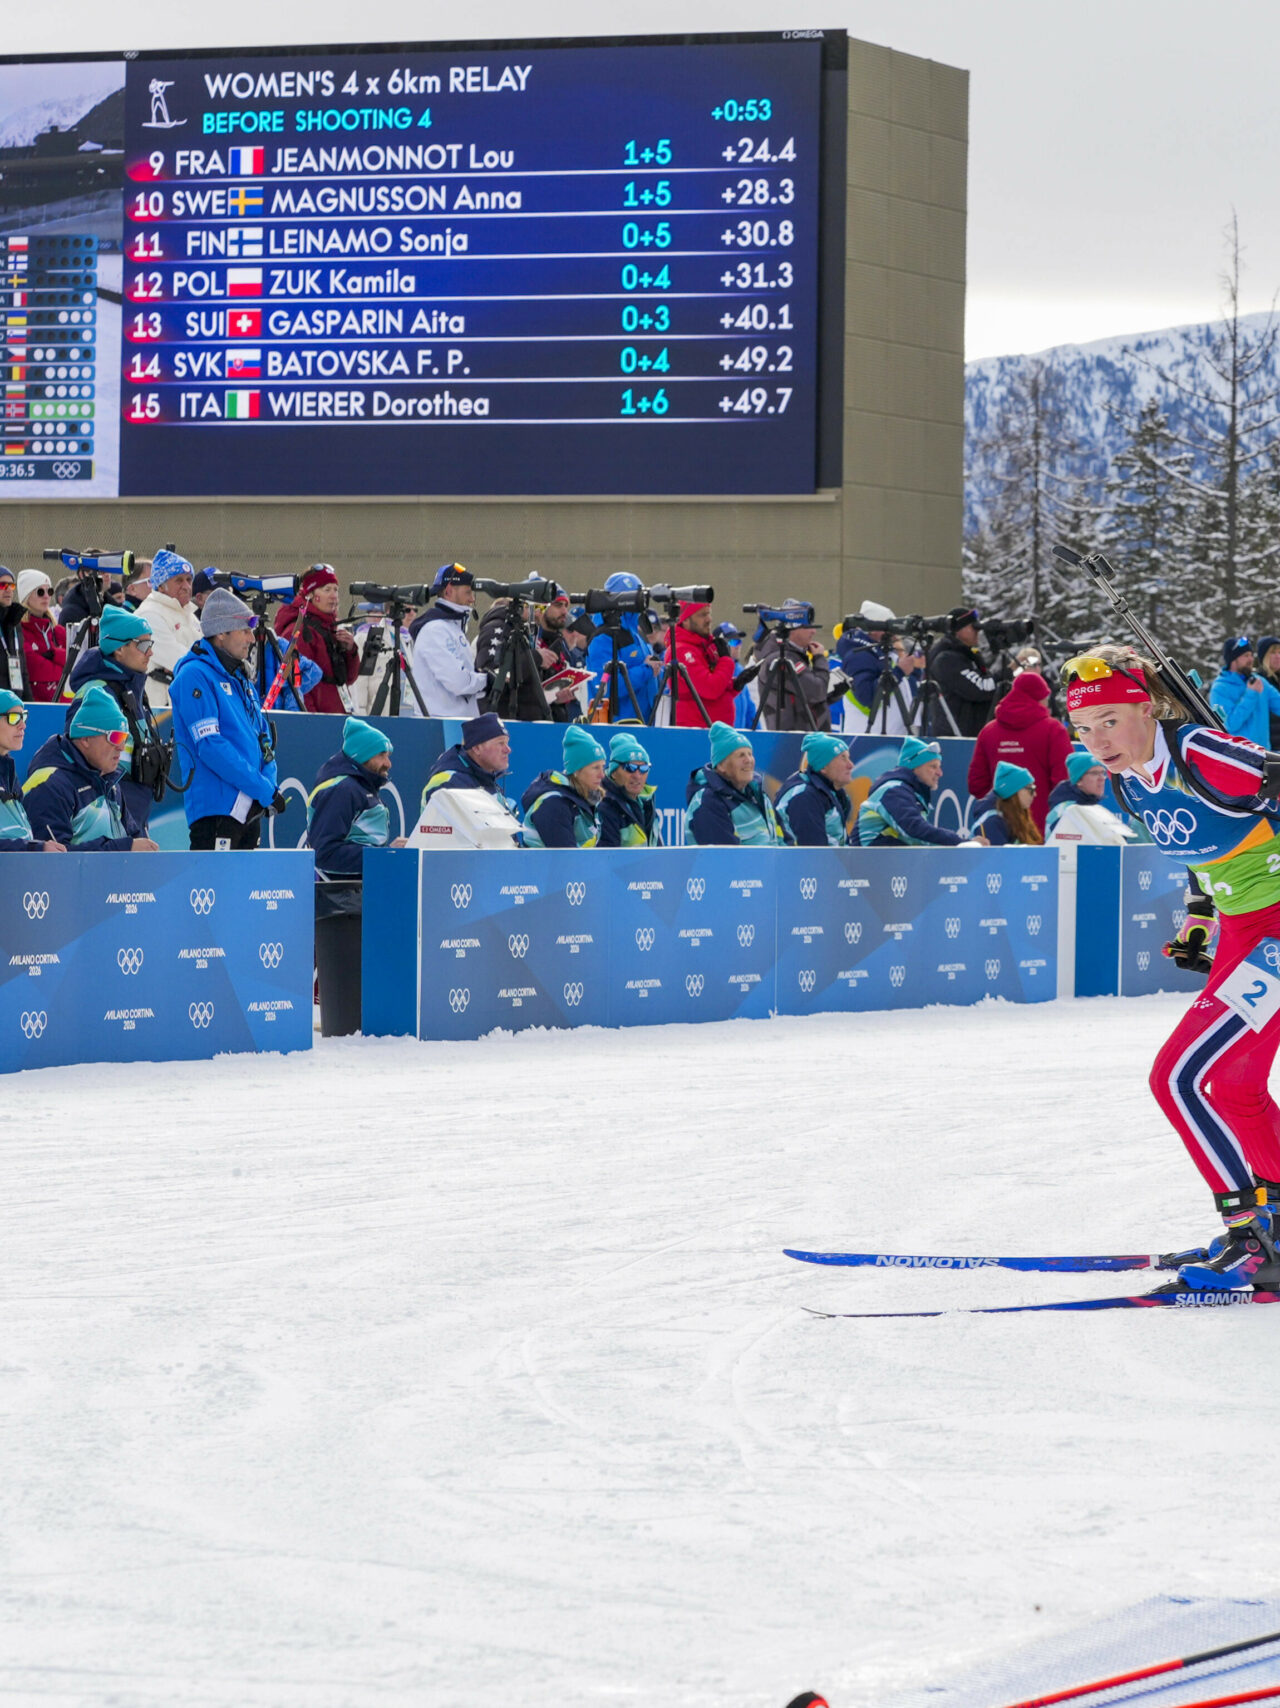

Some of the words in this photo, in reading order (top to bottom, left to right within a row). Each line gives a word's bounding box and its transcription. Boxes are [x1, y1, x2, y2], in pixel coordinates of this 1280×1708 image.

[204, 71, 335, 99] WOMEN'S
[341, 70, 359, 96] 4
[366, 77, 380, 95] x
[387, 68, 441, 95] 6km
[449, 65, 532, 93] RELAY
[203, 110, 284, 134] BEFORE
[295, 107, 413, 132] SHOOTING
[417, 108, 432, 129] 4
[711, 98, 772, 121] +0:53
[149, 151, 165, 176] 9
[175, 149, 226, 175] FRA
[271, 144, 463, 173] JEANMONNOT
[469, 143, 515, 169] Lou
[623, 139, 672, 165] 1+5
[722, 136, 796, 163] +24.4
[134, 190, 164, 217] 10
[172, 189, 226, 216] SWE
[270, 185, 447, 214] MAGNUSSON
[452, 184, 522, 211] Anna
[623, 180, 671, 206] 1+5
[721, 178, 795, 205] +28.3
[133, 231, 163, 258] 11
[186, 230, 226, 256] FIN
[269, 227, 392, 255] LEINAMO
[400, 226, 468, 257] Sonja
[622, 222, 671, 248] 0+5
[720, 219, 795, 247] +30.8
[133, 271, 163, 298] 12
[173, 271, 225, 297] POL
[269, 268, 322, 295] ZUK
[329, 267, 416, 294] Kamila
[622, 263, 671, 290] 0+4
[720, 262, 794, 289] +31.3
[132, 312, 162, 338] 13
[185, 311, 225, 338] SUI
[268, 308, 404, 336] GASPARIN
[410, 308, 465, 335] Aita
[621, 305, 671, 332] 0+3
[719, 303, 794, 330] +40.1
[131, 352, 161, 379] 14
[173, 351, 223, 378] SVK
[267, 349, 411, 377] BATOVSKA
[417, 349, 439, 375] F.
[447, 349, 471, 375] P.
[620, 346, 671, 374] 0+4
[719, 345, 793, 373] +49.2
[131, 393, 160, 419] 15
[180, 392, 222, 418] ITA
[267, 390, 366, 417] WIERER
[373, 390, 490, 417] Dorothea
[620, 388, 669, 415] 1+6
[718, 387, 793, 414] +49.7
[1069, 684, 1102, 698] NORGE
[106, 893, 131, 903] MILANO
[132, 893, 156, 903] CORTINA
[249, 890, 271, 899] MILANO
[272, 890, 294, 899] CORTINA
[9, 954, 35, 965] MILANO
[36, 954, 60, 965] CORTINA
[178, 948, 201, 958] MILANO
[202, 948, 225, 958] CORTINA
[248, 1001, 270, 1011] MILANO
[271, 1001, 293, 1011] CORTINA
[1241, 979, 1268, 1008] 2
[104, 1008, 129, 1020] MILANO
[130, 1008, 154, 1020] CORTINA
[876, 1255, 999, 1268] SALOMON
[1175, 1292, 1253, 1306] SALOMON
